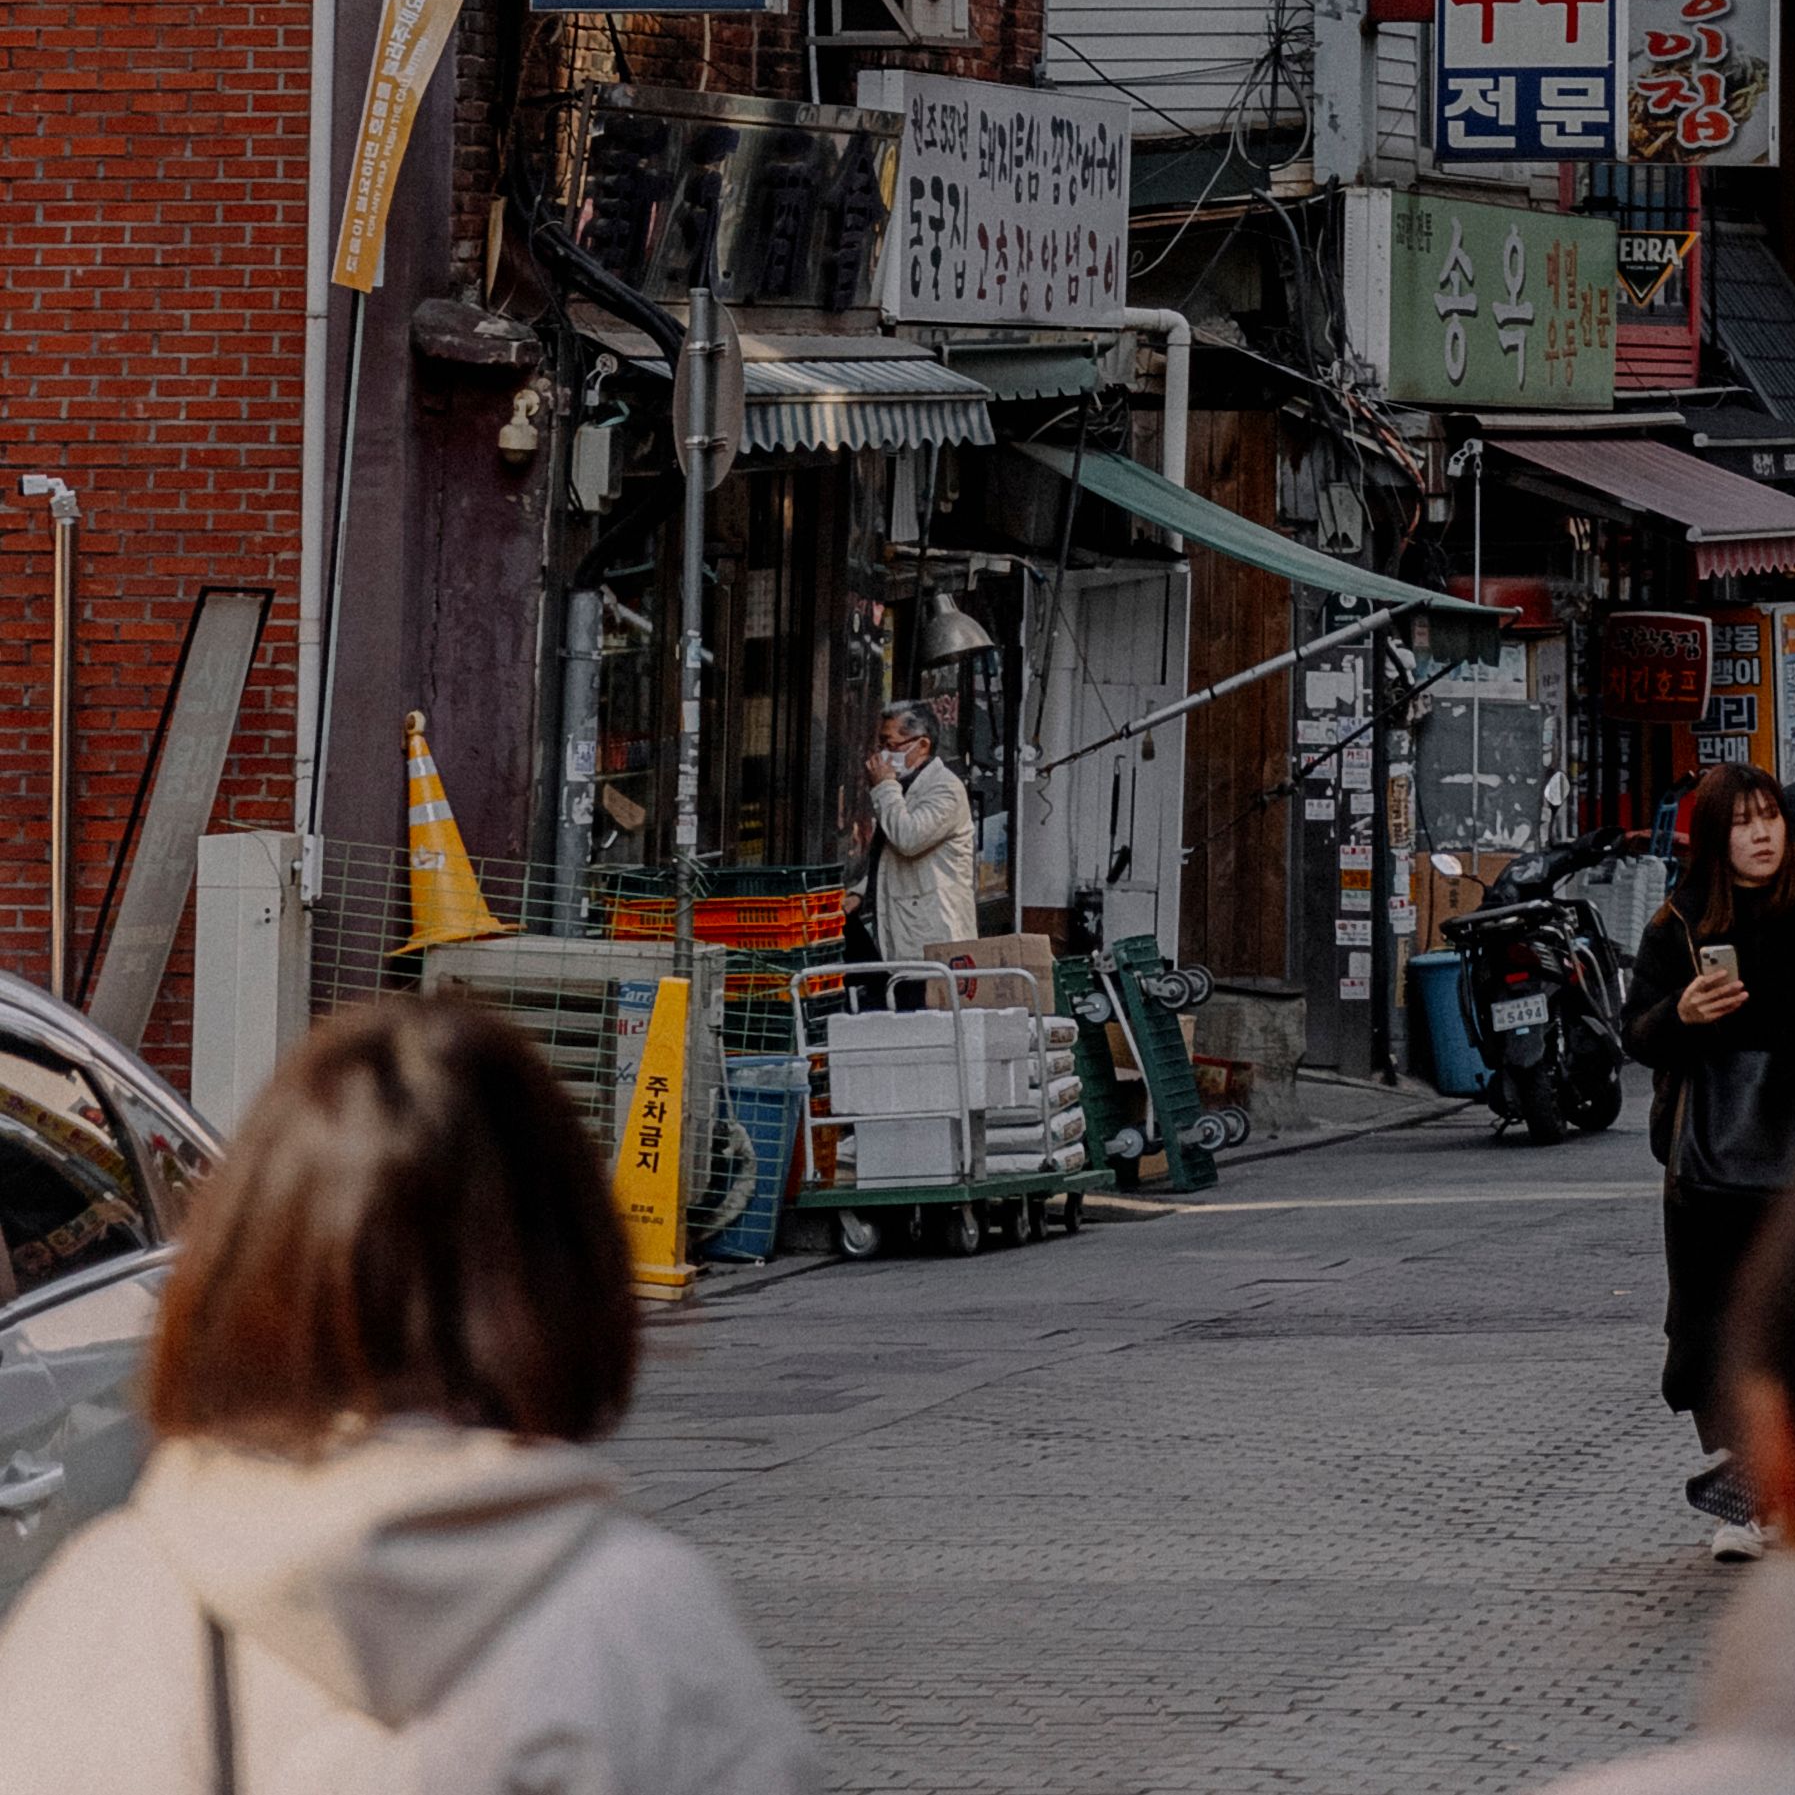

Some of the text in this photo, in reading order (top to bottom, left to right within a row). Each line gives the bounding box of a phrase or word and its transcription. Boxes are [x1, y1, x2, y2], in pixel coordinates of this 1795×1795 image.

[1443, 75, 1610, 150] 전문
[1618, 237, 1681, 266] ERRA
[1433, 216, 1536, 392] 송옥
[635, 1074, 670, 1175] 주차금지
